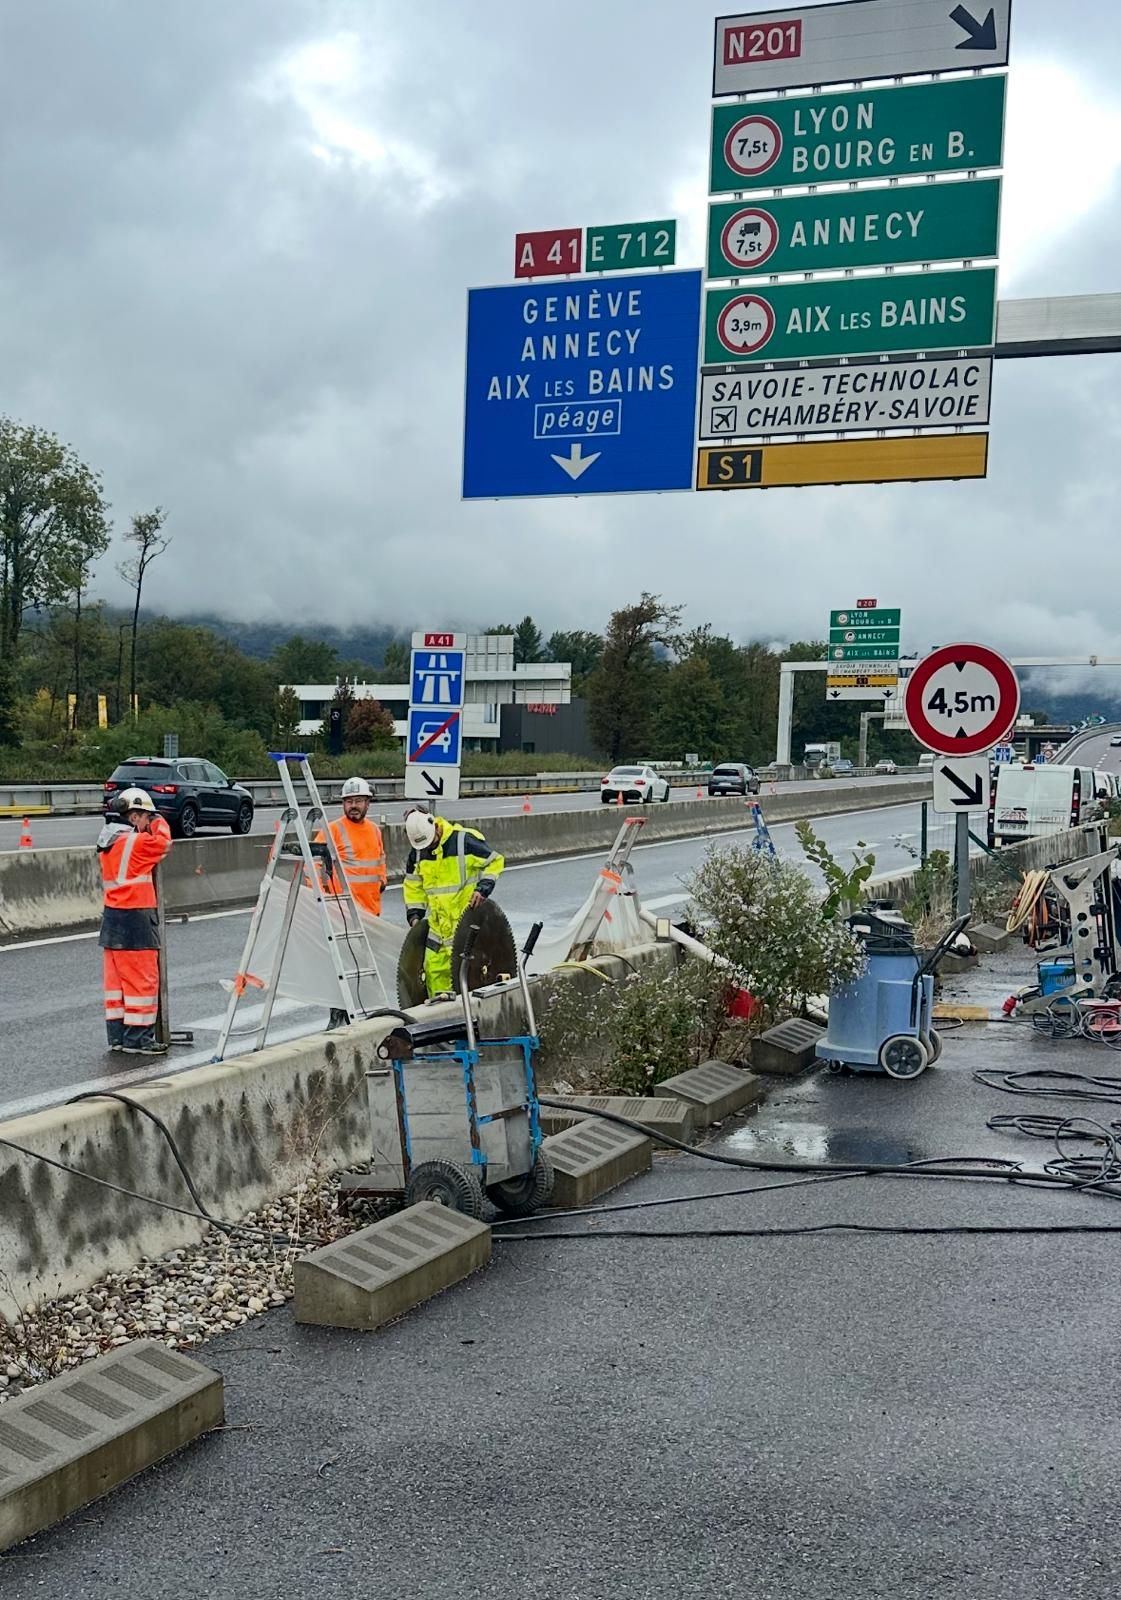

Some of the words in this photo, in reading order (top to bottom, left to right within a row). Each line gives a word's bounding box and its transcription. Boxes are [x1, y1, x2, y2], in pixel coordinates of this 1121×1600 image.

[729, 26, 796, 59] N201
[794, 102, 874, 136] LYON
[738, 138, 768, 158] 7,5t
[792, 137, 896, 173] BOURG
[909, 143, 933, 162] EN
[947, 131, 975, 159] B.
[591, 236, 605, 262] E
[617, 230, 670, 260] 712
[789, 210, 925, 248] ANNECY
[519, 242, 535, 268] A
[546, 238, 578, 265] 41
[736, 239, 762, 256] 7,5t
[523, 289, 642, 324] GENÈVE
[786, 305, 831, 334] AIX
[840, 311, 871, 331] LES
[880, 296, 966, 328] BAINS
[731, 318, 762, 334] 3,9m
[520, 328, 642, 362] ANNECY
[487, 374, 531, 401] AIX
[544, 380, 575, 398] LES
[588, 364, 675, 395] BAINS
[711, 365, 981, 402] SAVOIE-TECHNOLAC
[541, 405, 615, 435] péage
[746, 394, 980, 428] CHAMBÉRY-SAVOIE
[927, 687, 996, 718] 4,5m
